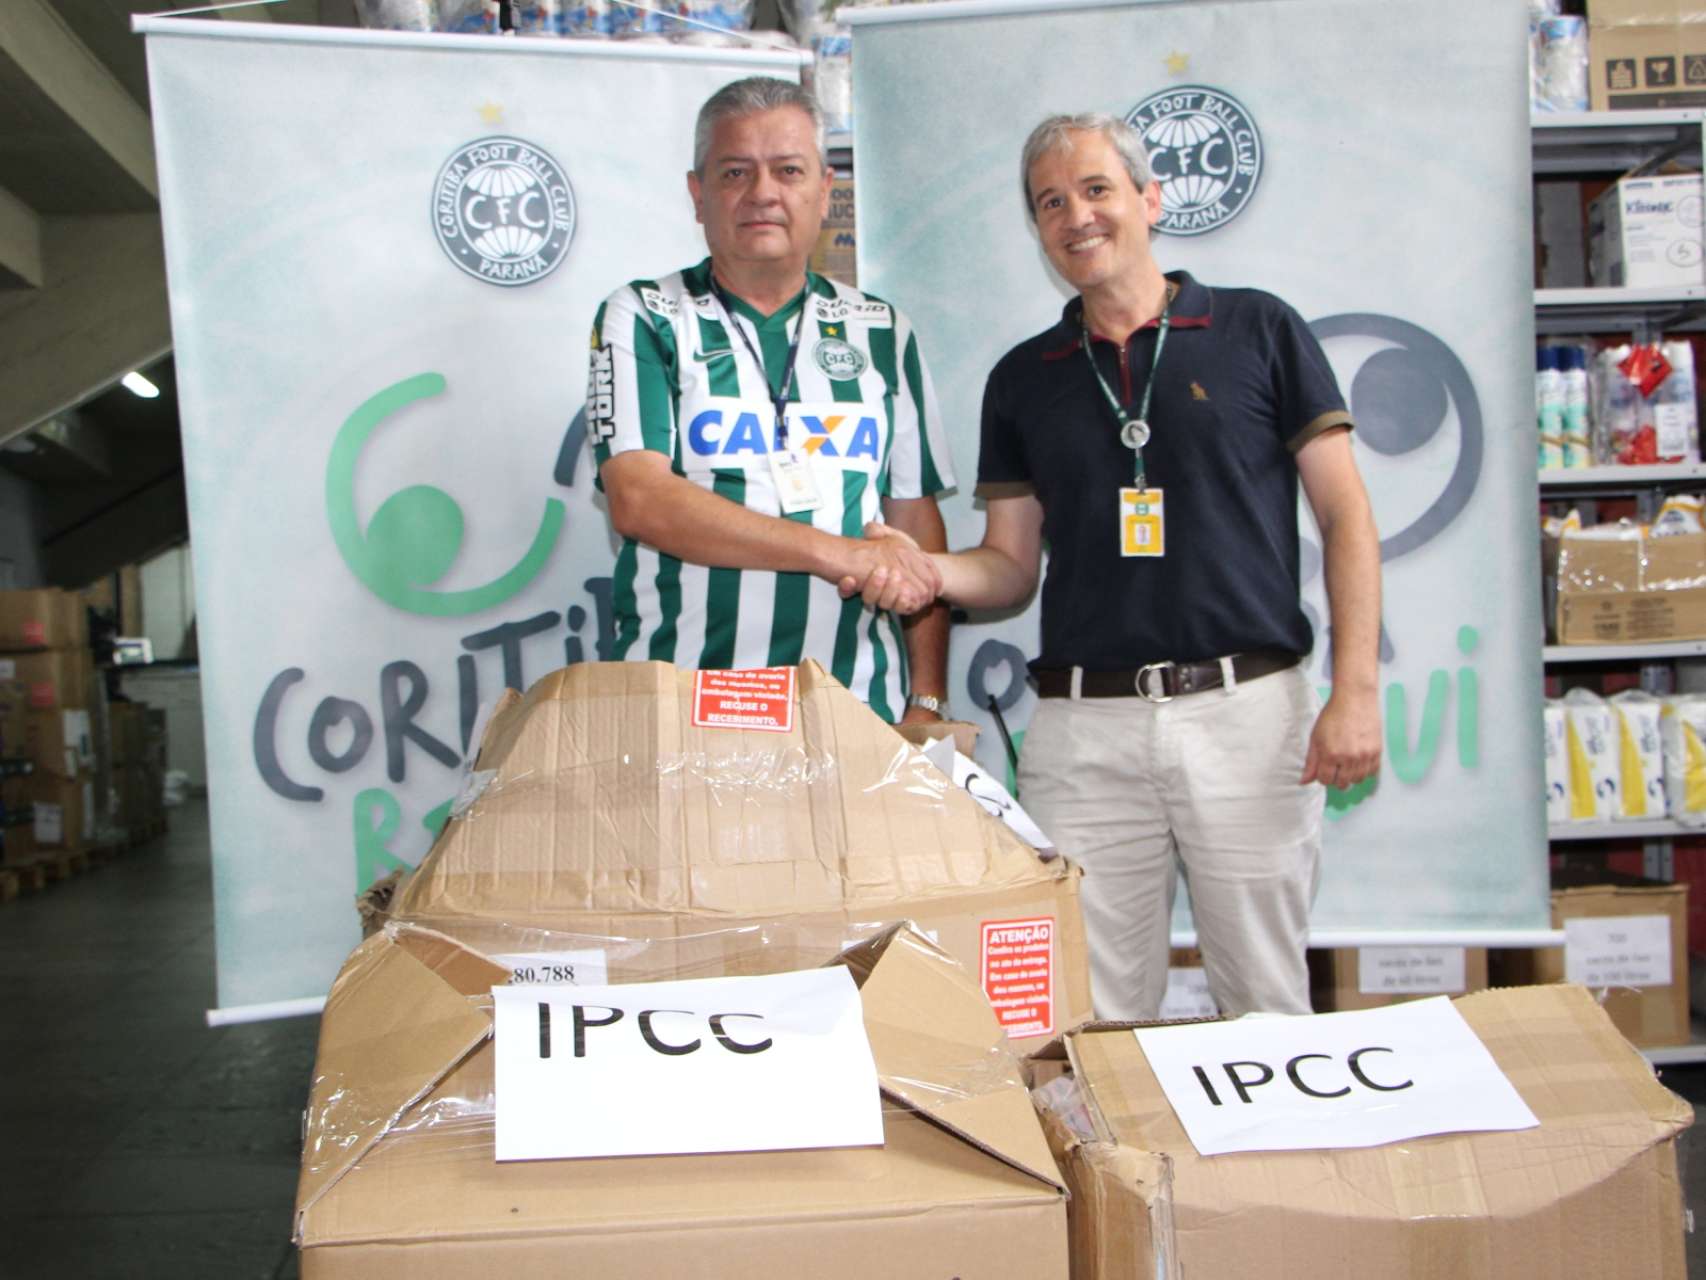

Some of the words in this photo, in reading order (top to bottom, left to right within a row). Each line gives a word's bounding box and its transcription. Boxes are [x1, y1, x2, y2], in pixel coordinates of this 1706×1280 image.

[1149, 138, 1228, 180] CFC
[1150, 94, 1199, 118] FOOT
[1201, 96, 1239, 130] BALL
[1235, 129, 1255, 176] CLUB
[439, 162, 468, 238] CORITIBA
[467, 144, 516, 168] FOOT
[516, 148, 554, 184] BALL
[551, 185, 571, 231] CLUB
[465, 191, 546, 230] CFC
[688, 410, 879, 462] CAIXA
[760, 703, 769, 711] O
[989, 926, 1049, 944] ATENÇÃO
[538, 1001, 773, 1060] IPCC
[1191, 1046, 1414, 1106] IPCC
